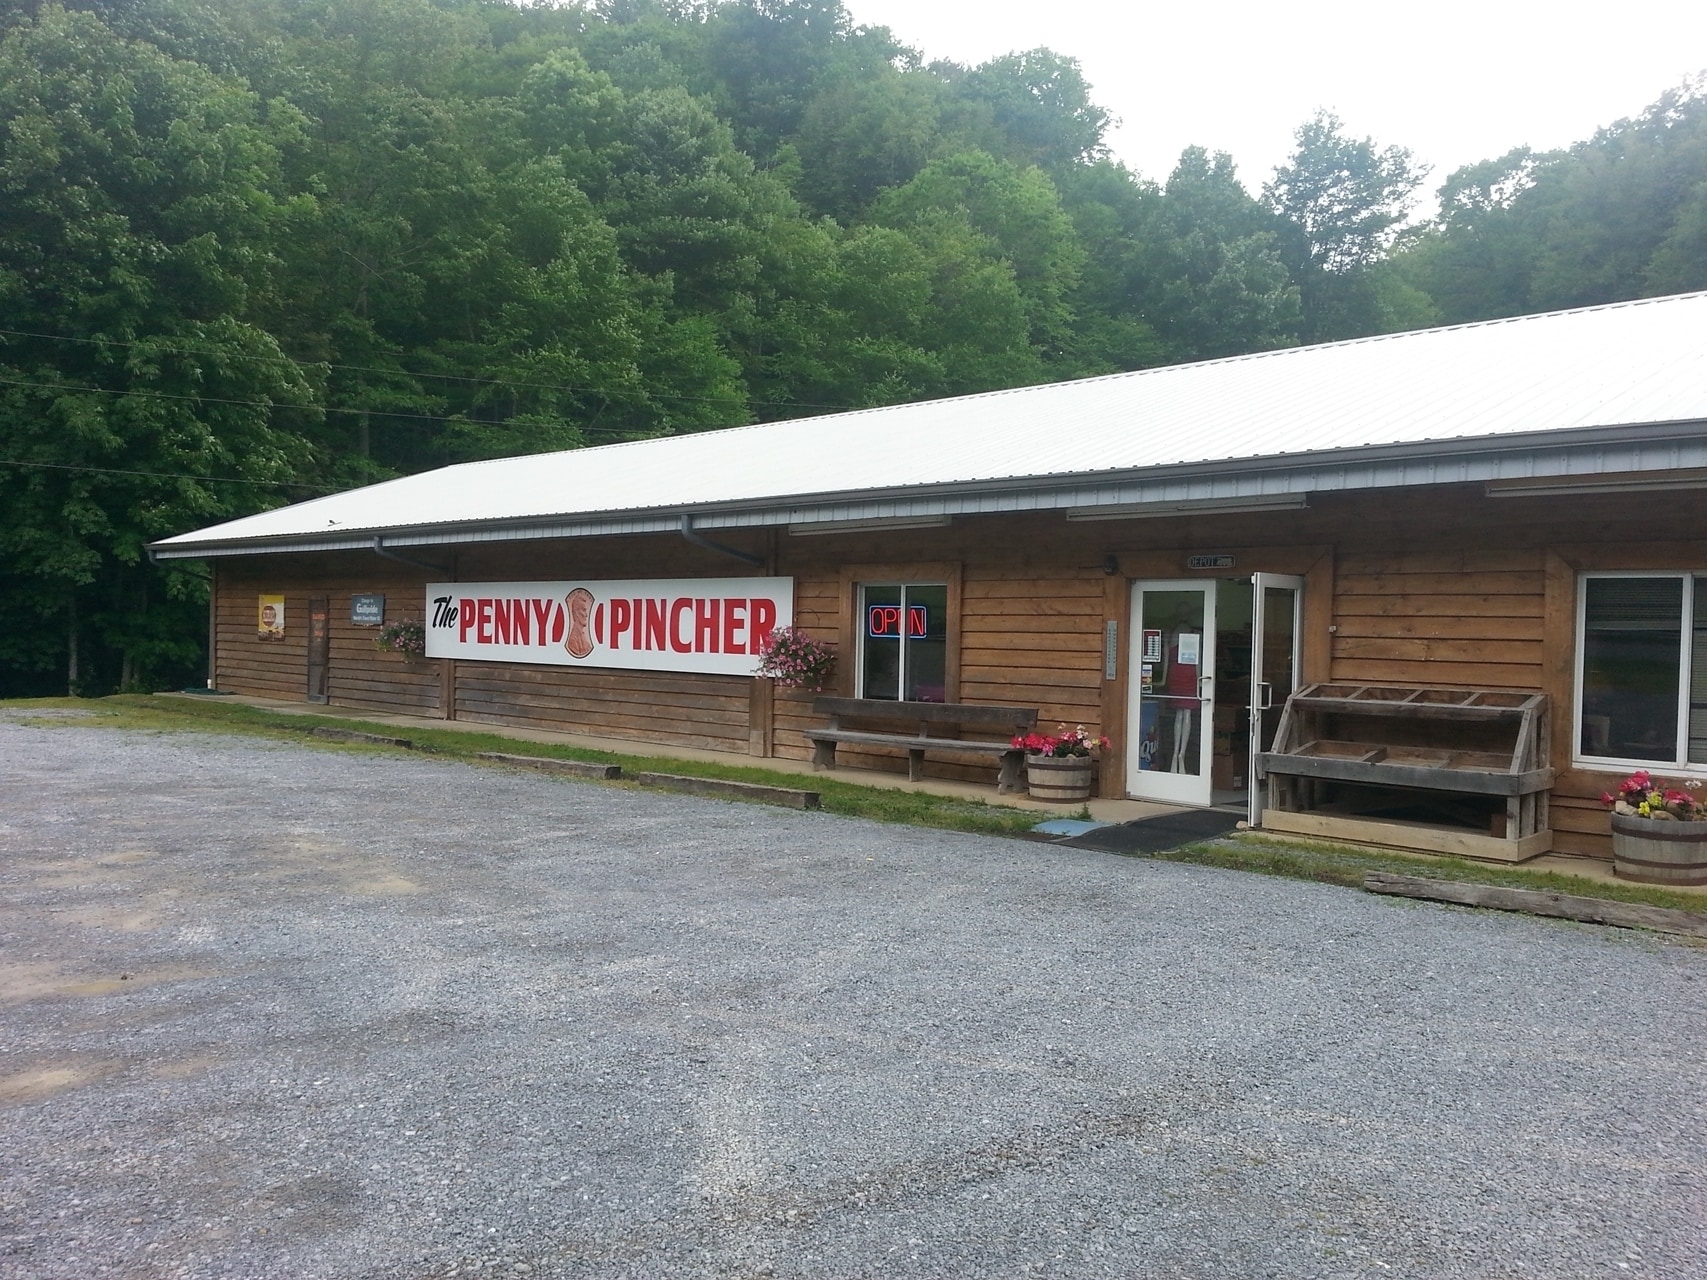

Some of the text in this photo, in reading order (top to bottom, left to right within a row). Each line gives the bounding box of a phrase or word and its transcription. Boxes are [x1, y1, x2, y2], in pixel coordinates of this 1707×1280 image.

[432, 595, 777, 655] The PENNY PINCHER
